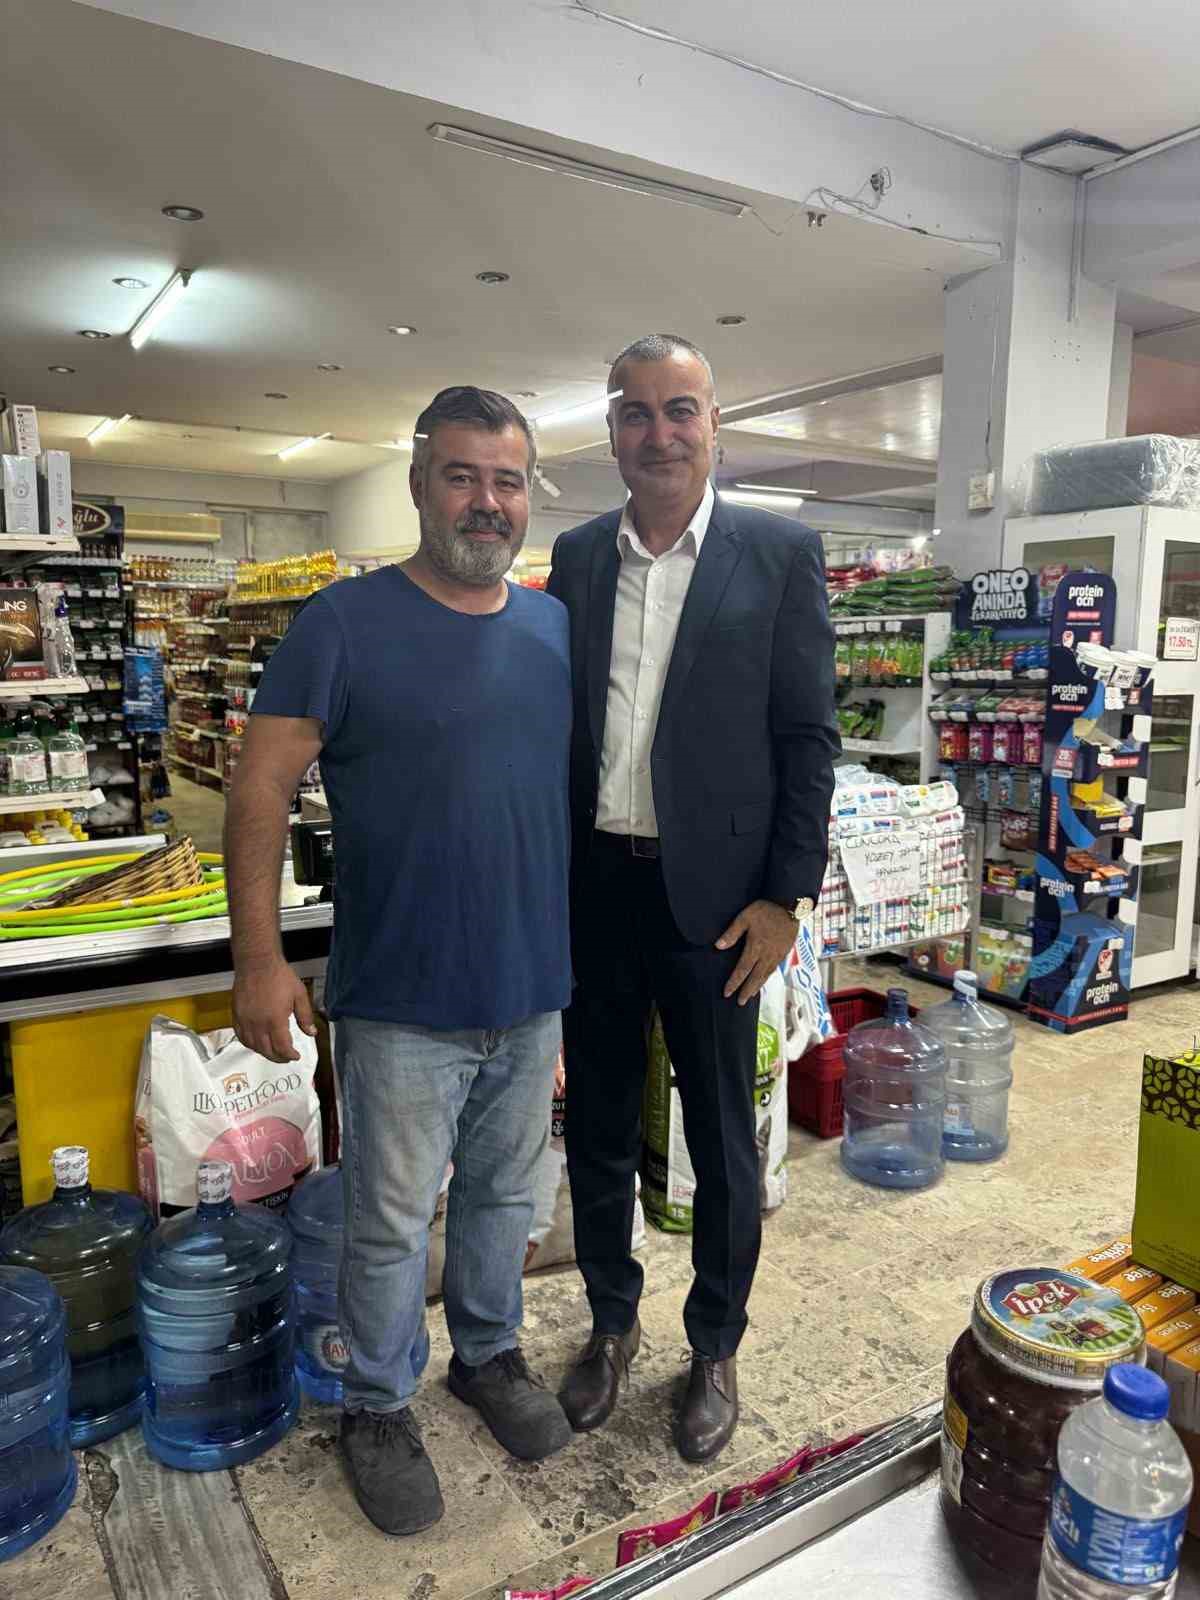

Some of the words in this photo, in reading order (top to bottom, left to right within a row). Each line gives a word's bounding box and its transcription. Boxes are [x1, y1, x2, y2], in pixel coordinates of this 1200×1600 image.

[1068, 584, 1104, 600] protein
[1051, 683, 1088, 696] protein
[1040, 877, 1075, 893] protein
[1086, 982, 1119, 1001] protein
